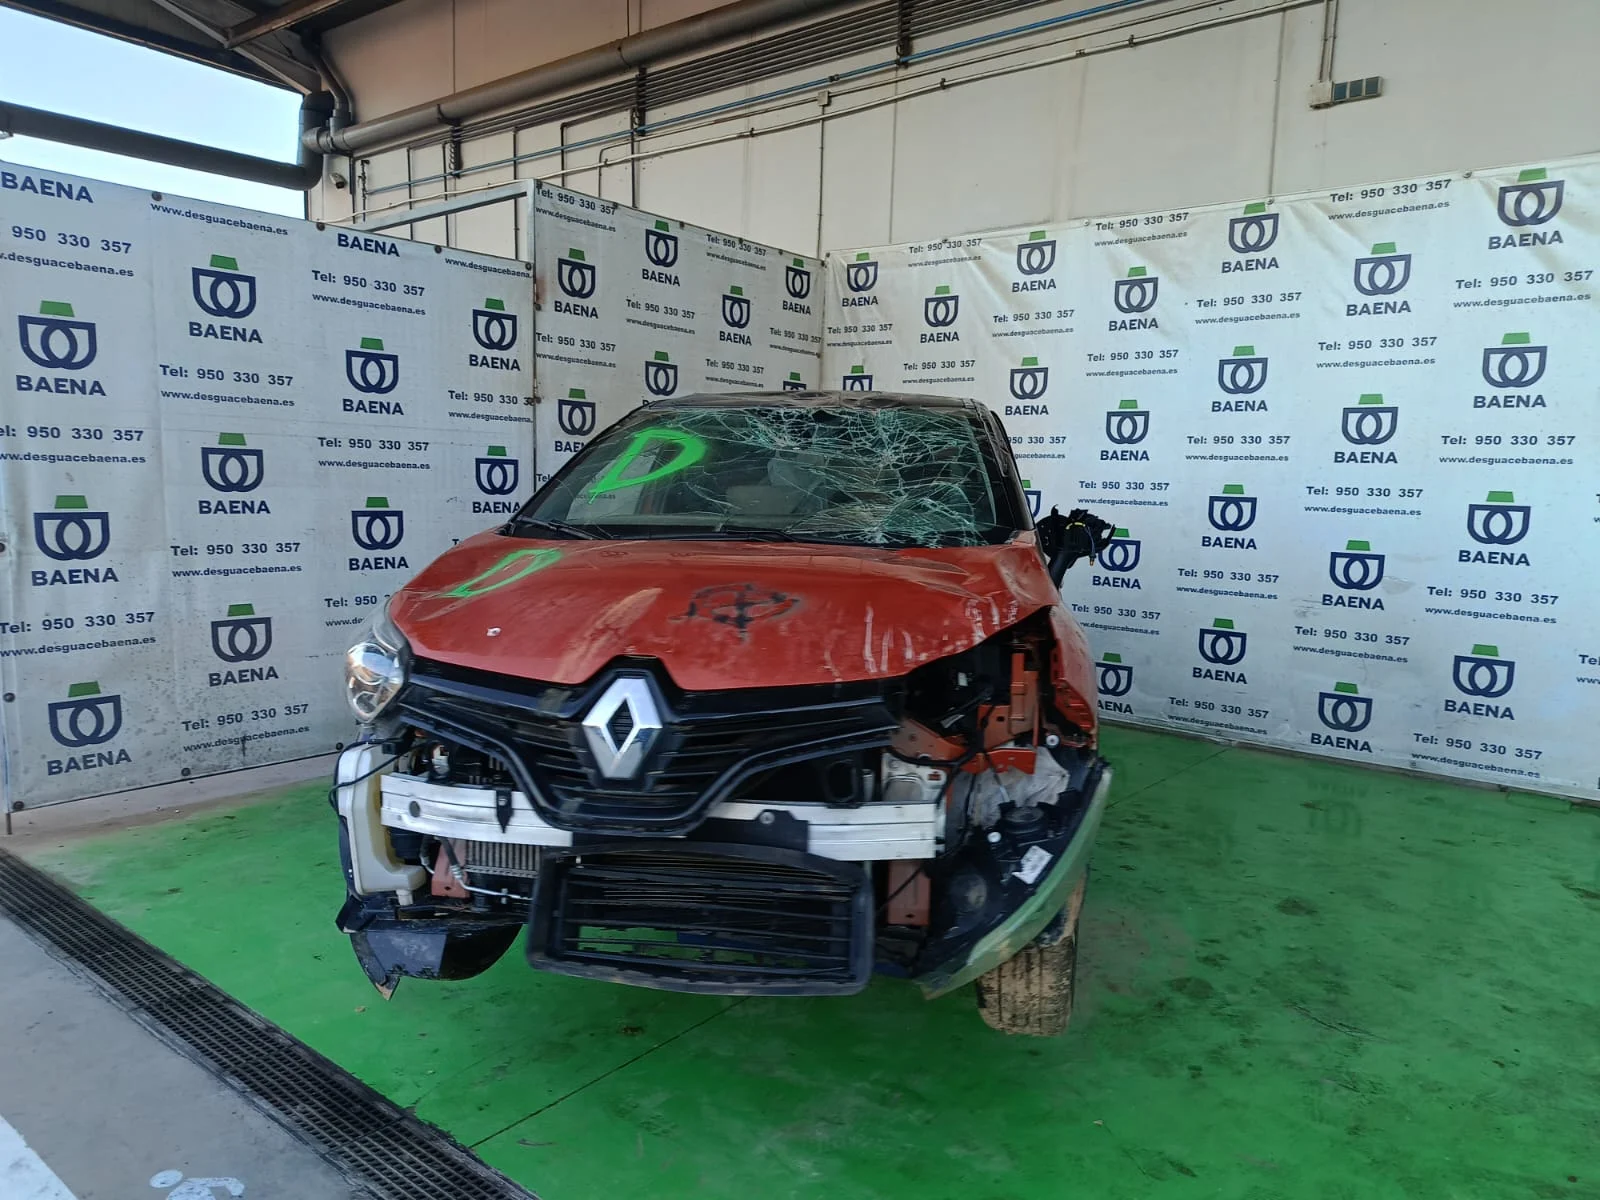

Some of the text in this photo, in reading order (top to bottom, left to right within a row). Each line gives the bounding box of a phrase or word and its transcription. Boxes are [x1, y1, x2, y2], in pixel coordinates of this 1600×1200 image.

[1, 172, 93, 203] BAENA
[1330, 179, 1452, 202] Tel: 950 330 357
[1328, 201, 1450, 220] www.desguacebaena.es
[150, 202, 289, 235] www.desguacebaena.es
[1096, 212, 1189, 231] Tel: 950 330 357
[12, 226, 131, 254] 950 330 357
[338, 232, 401, 257] BAENA
[1095, 232, 1187, 246] www.desguacebaena.es
[1488, 230, 1563, 249] BAENA
[1221, 257, 1279, 273] BAENA
[312, 270, 425, 296] Tel: 950 330 357
[642, 269, 680, 286] BAENA
[1456, 270, 1593, 289] Tel: 950 330 357
[1012, 279, 1056, 292] BAENA
[312, 294, 426, 315] www.desguacebaena.es
[842, 296, 878, 307] BAENA
[1196, 292, 1302, 307] Tel: 950 330 357
[1453, 294, 1591, 308] www.desguacebaena.es
[554, 300, 598, 319] BAENA
[626, 299, 695, 319] Tel: 950 330 357
[783, 300, 811, 315] BAENA
[1346, 301, 1411, 316] BAENA
[993, 309, 1075, 323] Tel: 950 330 357
[1195, 313, 1300, 324] www.desguacebaena.es
[1109, 318, 1159, 331] BAENA
[189, 322, 263, 343] BAENA
[720, 331, 752, 346] BAENA
[920, 331, 959, 343] BAENA
[535, 331, 616, 352] Tel: 950 330 357
[1318, 337, 1437, 351] Tel: 950 330 357
[469, 354, 520, 371] BAENA
[535, 351, 616, 369] www.desguacebaena.es
[922, 362, 936, 370] 950
[1316, 358, 1435, 368] www.desguacebaena.es
[159, 364, 293, 386] Tel: 950 330 357
[16, 375, 106, 396] BAENA
[161, 391, 295, 406] www.desguacebaena.es
[1212, 400, 1268, 412] BAENA
[1473, 395, 1546, 408] BAENA
[343, 399, 404, 415] BAENA
[1005, 405, 1049, 415] BAENA
[27, 426, 143, 441] 950 330 357
[1187, 436, 1290, 444] Tel: 950 330 357
[1441, 436, 1576, 445] Tel: 950 330 357
[317, 437, 429, 451] Tel: 950 330 357
[1100, 450, 1149, 461] BAENA
[1334, 452, 1398, 463] BAENA
[1439, 456, 1573, 465] www.desguacebaena.es
[318, 460, 430, 469] www.desguacebaena.es
[1102, 481, 1120, 489] 950
[1126, 482, 1144, 490] 330
[1150, 482, 1170, 491] 357
[1306, 486, 1423, 498] Tel: 950 330 357
[199, 500, 271, 514] BAENA
[472, 501, 521, 514] BAENA
[1304, 506, 1421, 515] www.desguacebaena.es
[170, 543, 300, 556] Tel: 950 330 357
[1202, 536, 1257, 550] BAENA
[349, 556, 409, 571] BAENA
[1458, 550, 1530, 566] BAENA
[32, 568, 119, 586] BAENA
[172, 566, 302, 577] www.desguacebaena.es
[1178, 568, 1279, 583] Tel: 950 330 357
[1092, 576, 1141, 589] BAENA
[1322, 594, 1384, 610] BAENA
[1427, 586, 1559, 605] Tel: 950 330 357
[0, 612, 155, 634] Tel: 950 330 357
[1425, 608, 1556, 623] www.desguacebaena.es
[1295, 626, 1410, 645] Tel: 950 330 357
[208, 666, 279, 687] BAENA
[1192, 667, 1247, 684] BAENA
[1444, 699, 1514, 720] BAENA
[181, 704, 308, 731] Tel: 950 330 357
[1311, 733, 1372, 753] BAENA
[1413, 733, 1542, 760] Tel: 950 330 357
[47, 749, 132, 776] BAENA
